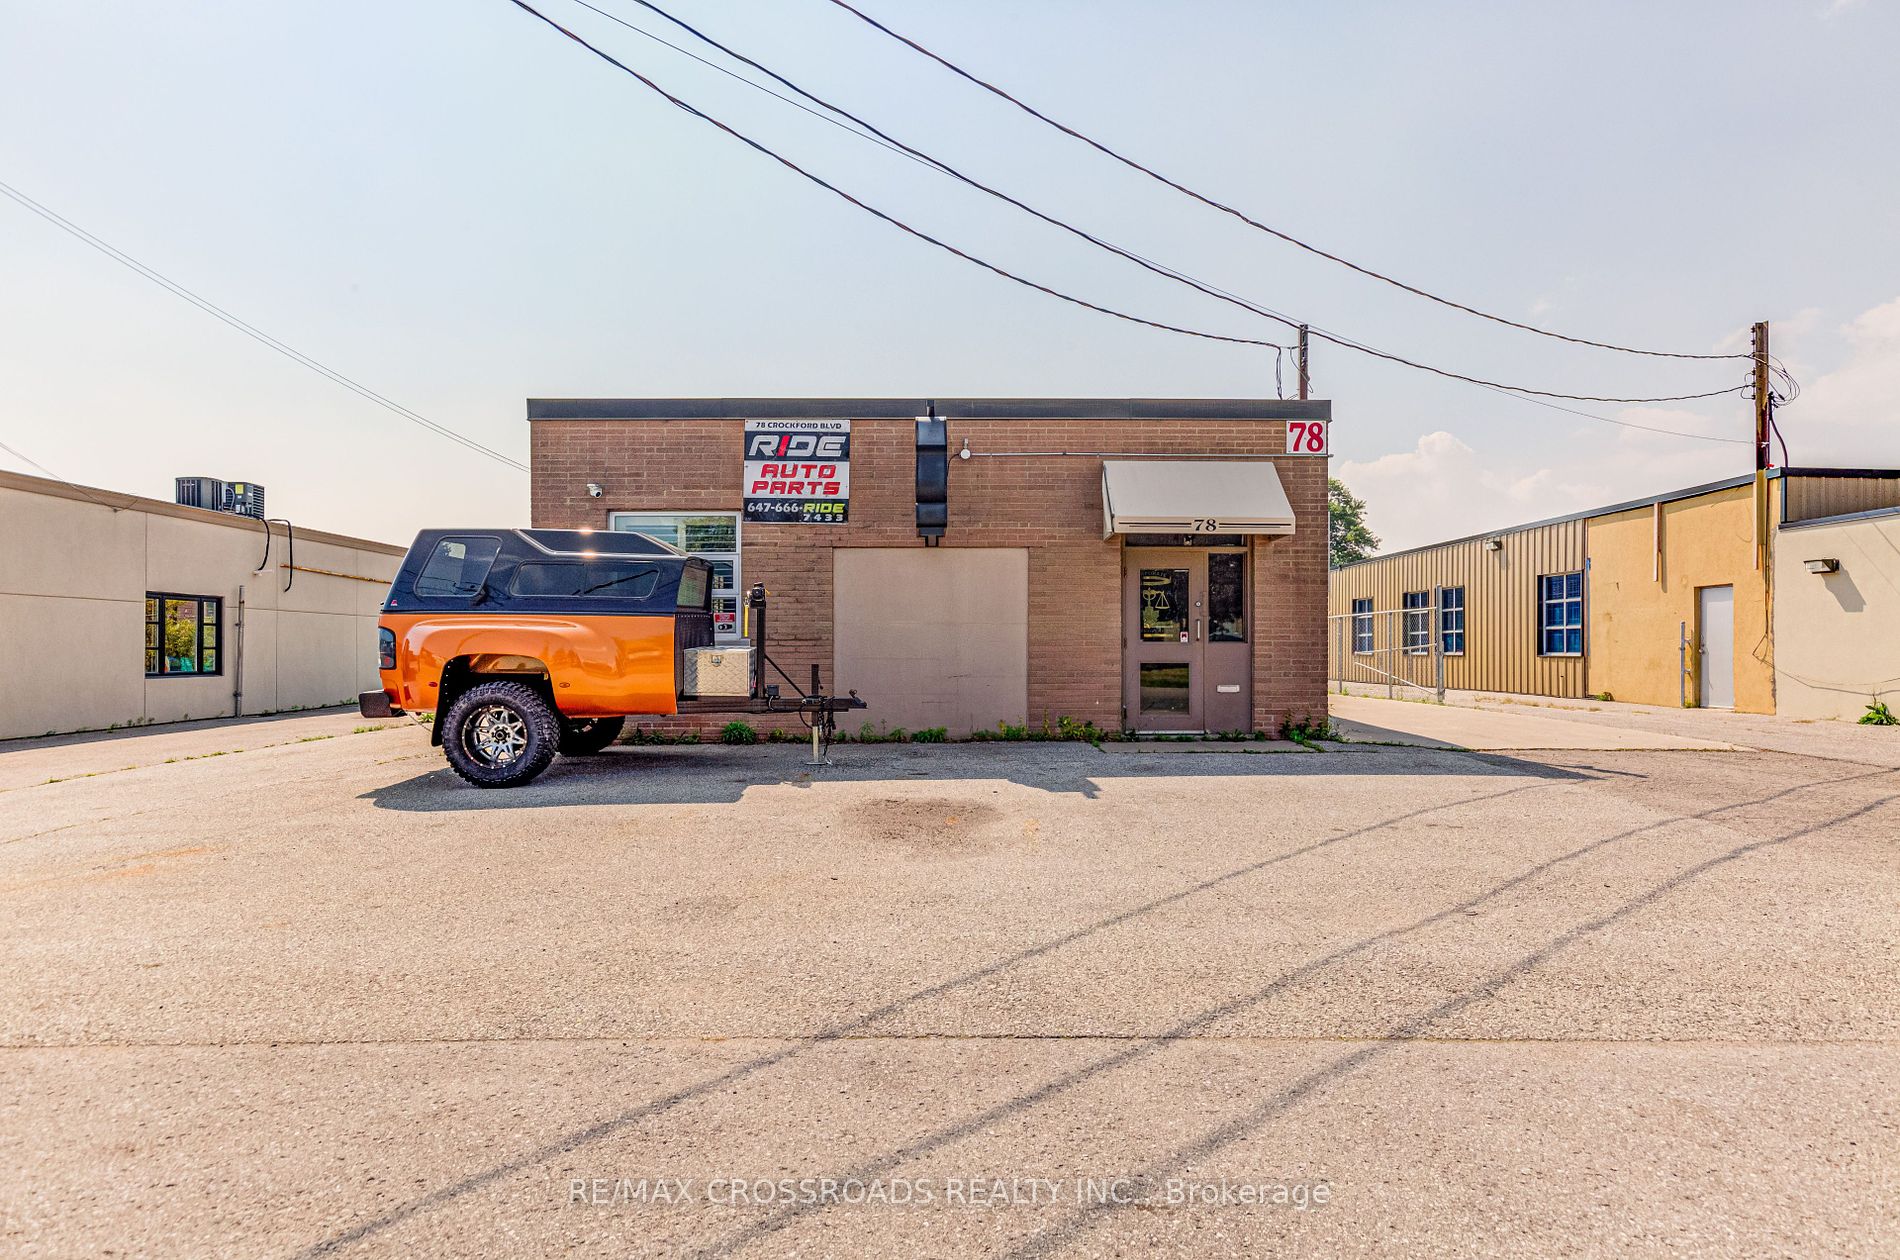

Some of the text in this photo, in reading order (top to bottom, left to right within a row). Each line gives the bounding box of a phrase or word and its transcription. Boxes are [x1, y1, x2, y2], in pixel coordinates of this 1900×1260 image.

[820, 422, 842, 430] BLVD
[1289, 422, 1324, 452] 78
[748, 435, 846, 457] RIDE
[761, 464, 837, 478] AUTO
[752, 481, 840, 495] PARTS
[1193, 519, 1217, 532] 78
